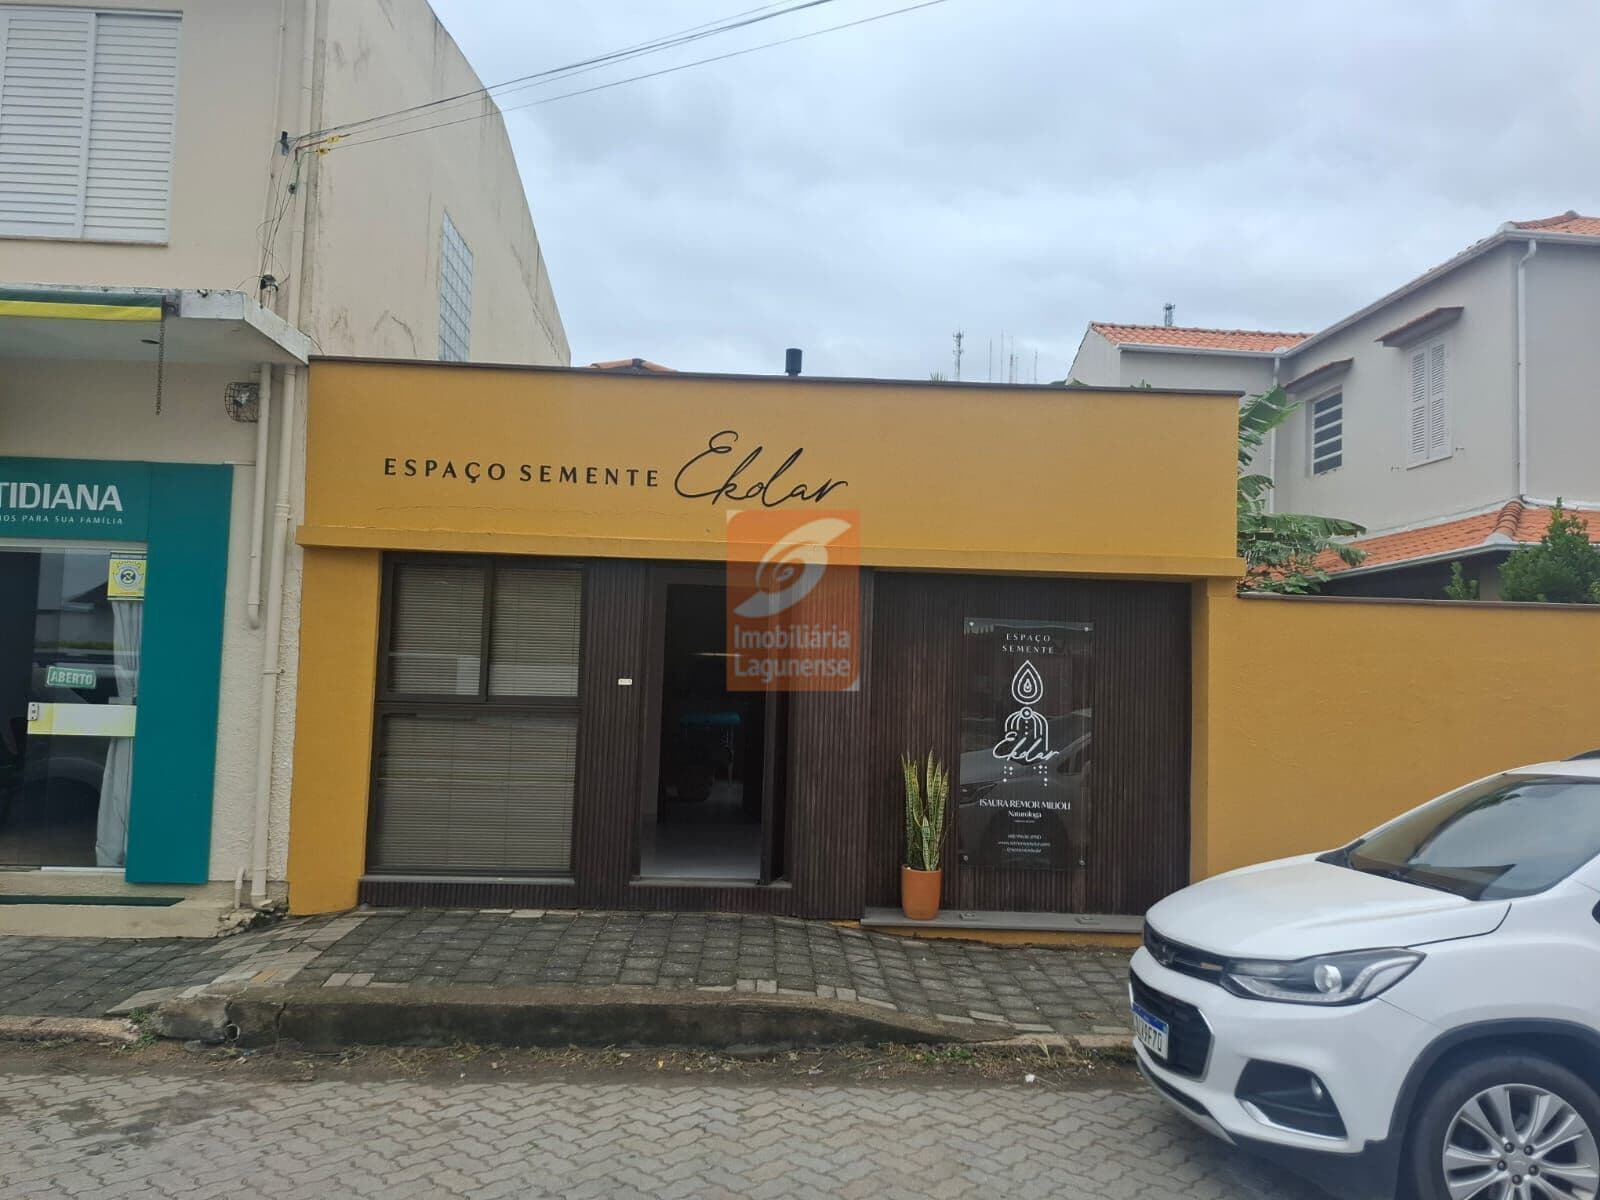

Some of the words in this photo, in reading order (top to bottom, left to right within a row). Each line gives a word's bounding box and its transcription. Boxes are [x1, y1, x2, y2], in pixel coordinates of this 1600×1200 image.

[384, 457, 506, 484] ESPAÇO
[519, 464, 659, 488] SEMENTE
[22, 515, 49, 523] PARA
[55, 515, 75, 523] SUA
[1006, 633, 1051, 643] ESPAÇO
[1002, 645, 1054, 654] SEMENTE
[50, 671, 93, 685] ABERTO
